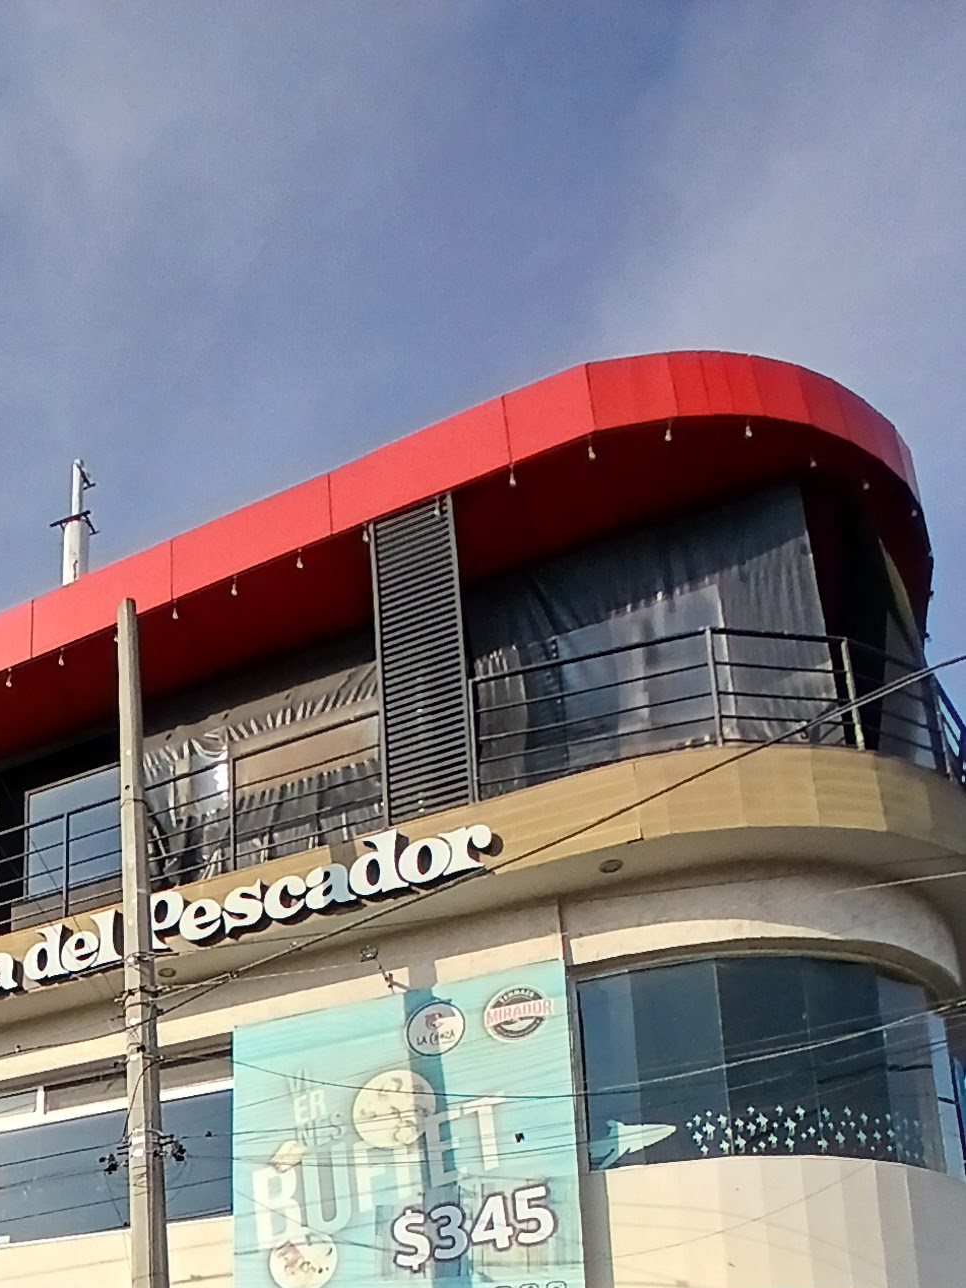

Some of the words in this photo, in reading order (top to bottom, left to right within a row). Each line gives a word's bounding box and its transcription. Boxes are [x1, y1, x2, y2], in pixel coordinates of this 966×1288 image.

[23, 910, 123, 981] del
[150, 824, 492, 950] Pescador
[486, 1000, 552, 1026] MIRADOR
[392, 1184, 558, 1274] $345
